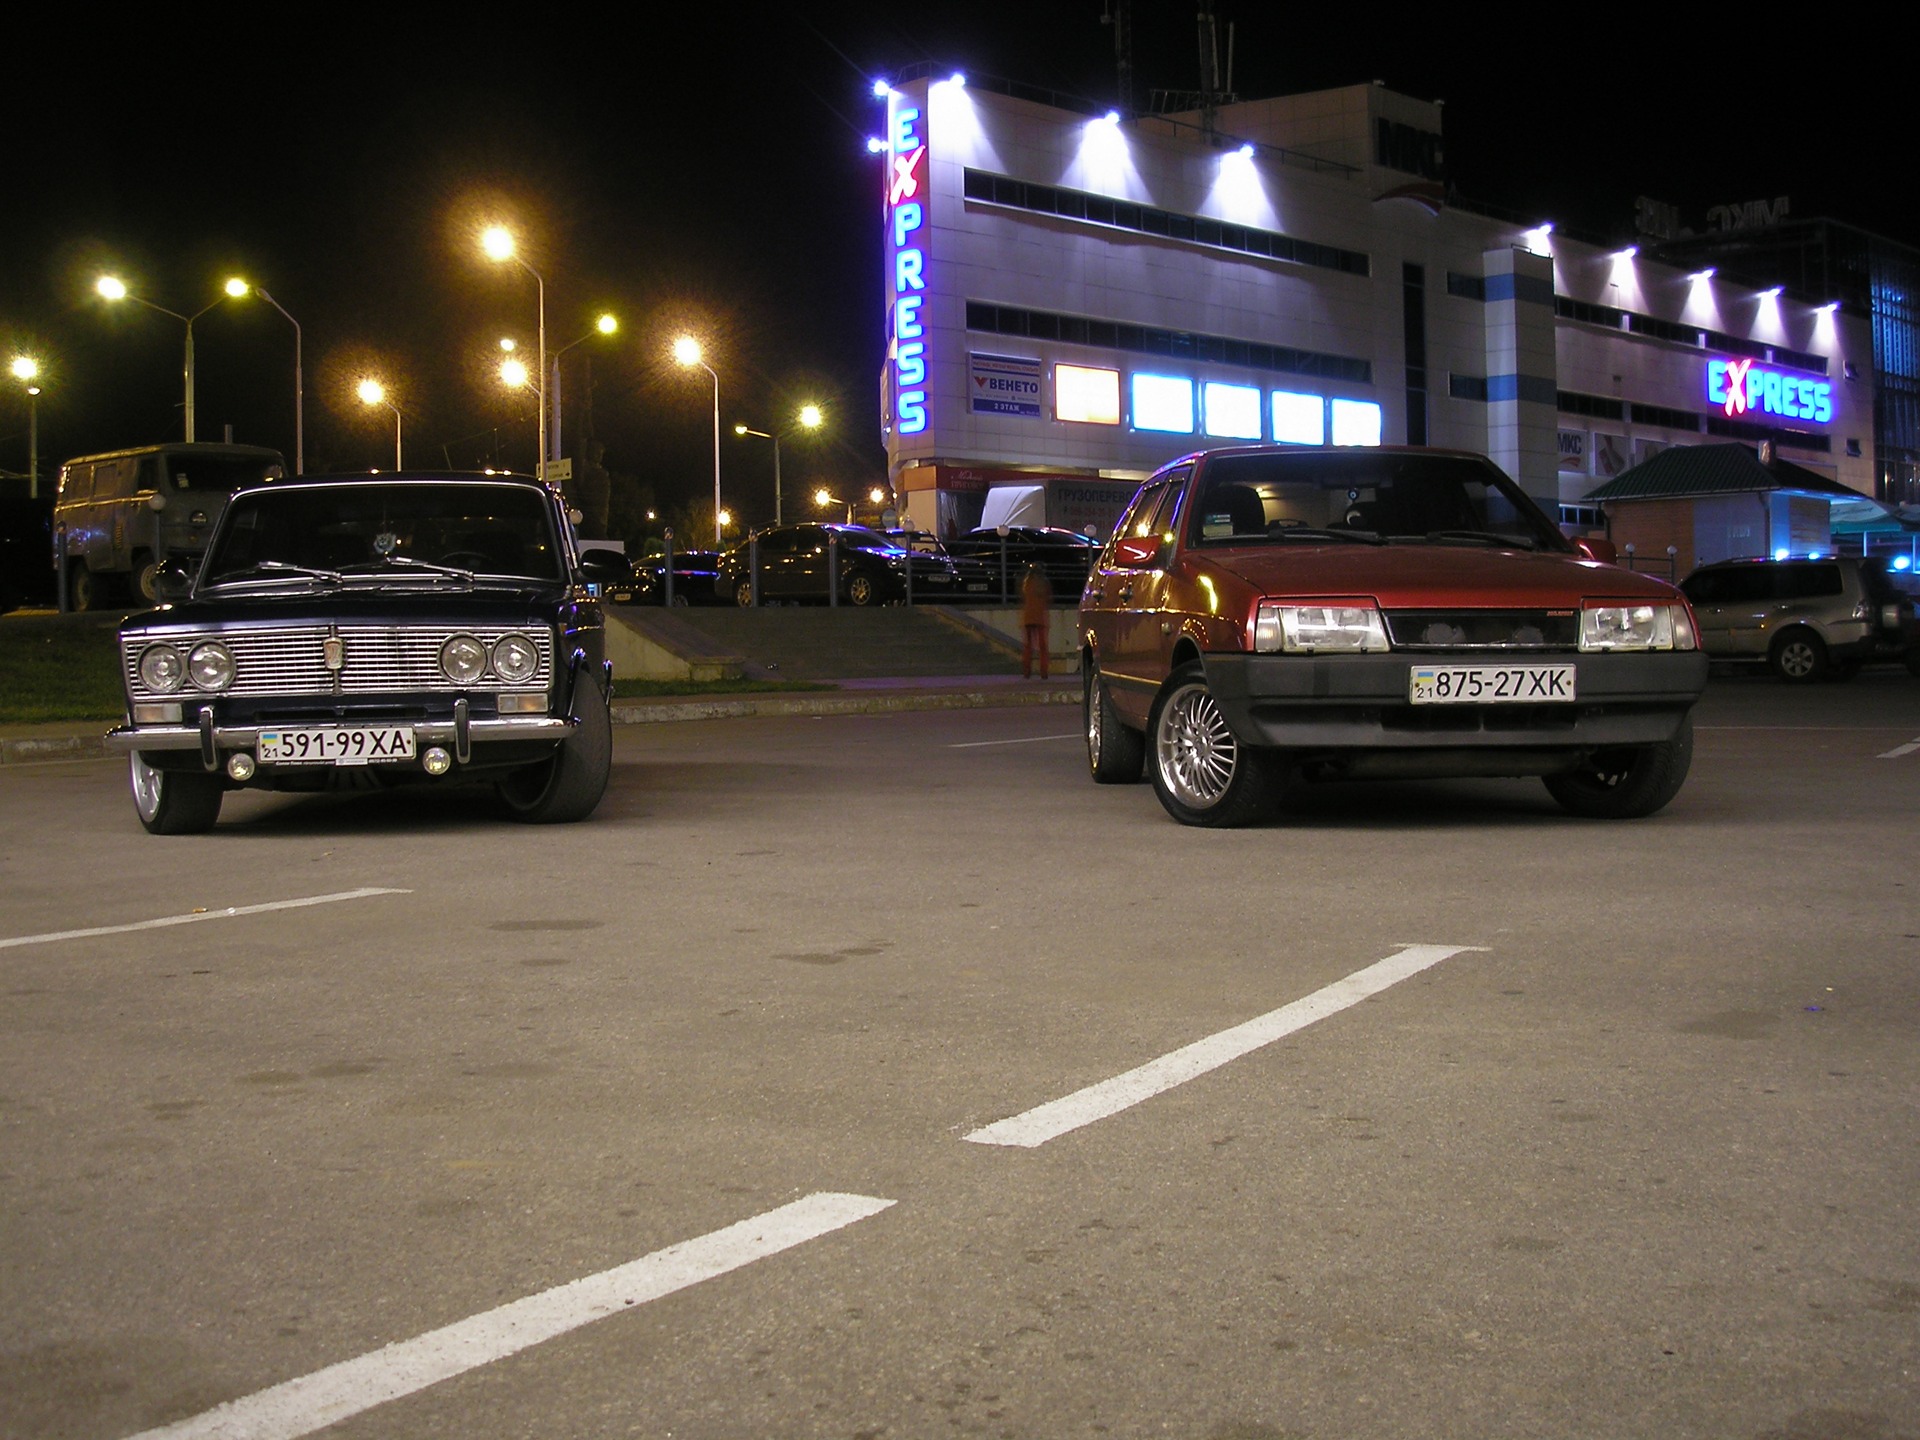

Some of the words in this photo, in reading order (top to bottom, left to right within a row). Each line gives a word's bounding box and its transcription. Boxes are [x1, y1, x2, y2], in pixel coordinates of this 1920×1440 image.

[890, 107, 927, 434] EXPRESS
[989, 378, 1039, 393] ВЕНЕТО
[1708, 358, 1831, 423] EXPRESS
[1058, 488, 1133, 504] ГРУЗОПЕРЕВО
[1417, 687, 1433, 698] 21
[1436, 670, 1566, 697] 875-27XK
[264, 748, 278, 758] 21
[281, 730, 407, 757] 591-99XA
